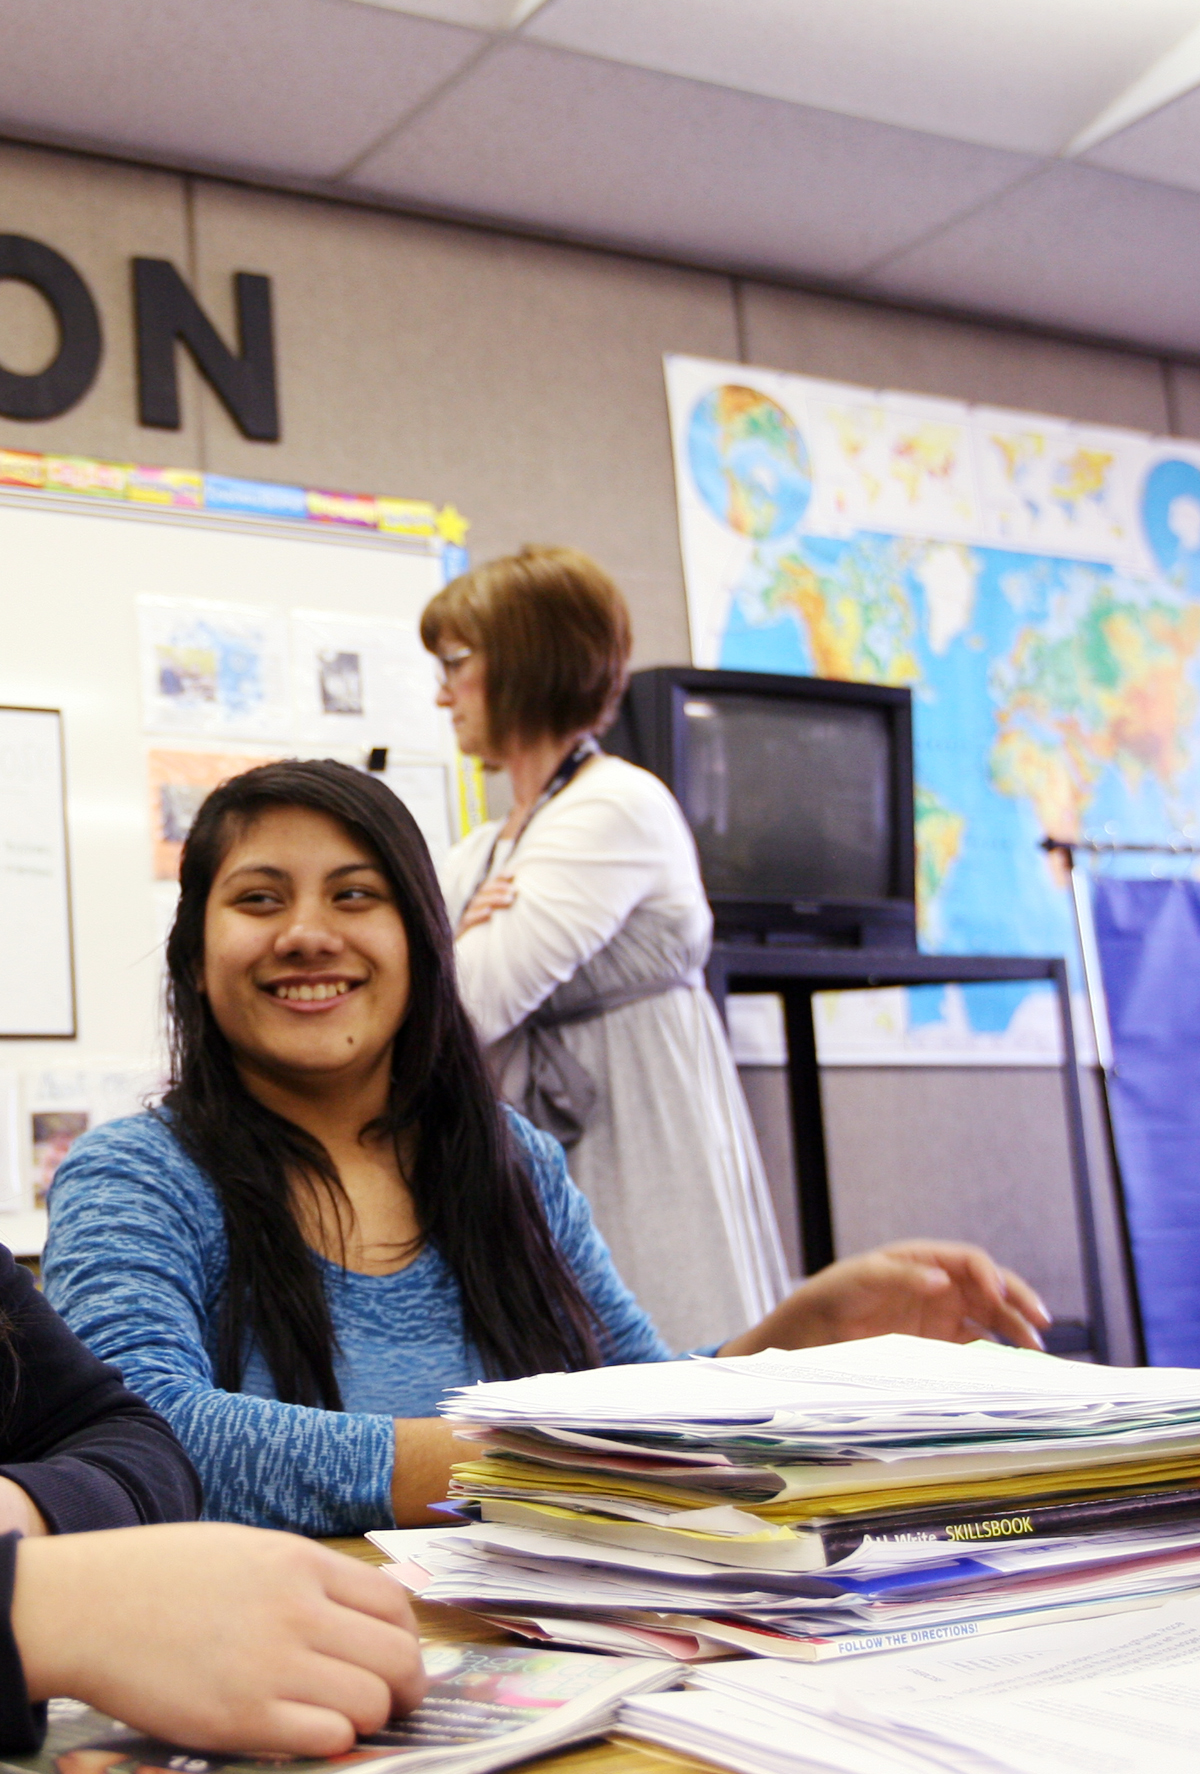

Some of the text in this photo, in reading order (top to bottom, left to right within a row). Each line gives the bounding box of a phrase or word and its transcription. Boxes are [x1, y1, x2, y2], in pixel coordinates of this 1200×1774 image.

[945, 1516, 1033, 1542] SKILLSBOOK
[838, 1623, 979, 1653] FOLLOW THE DIRECTIONS!
